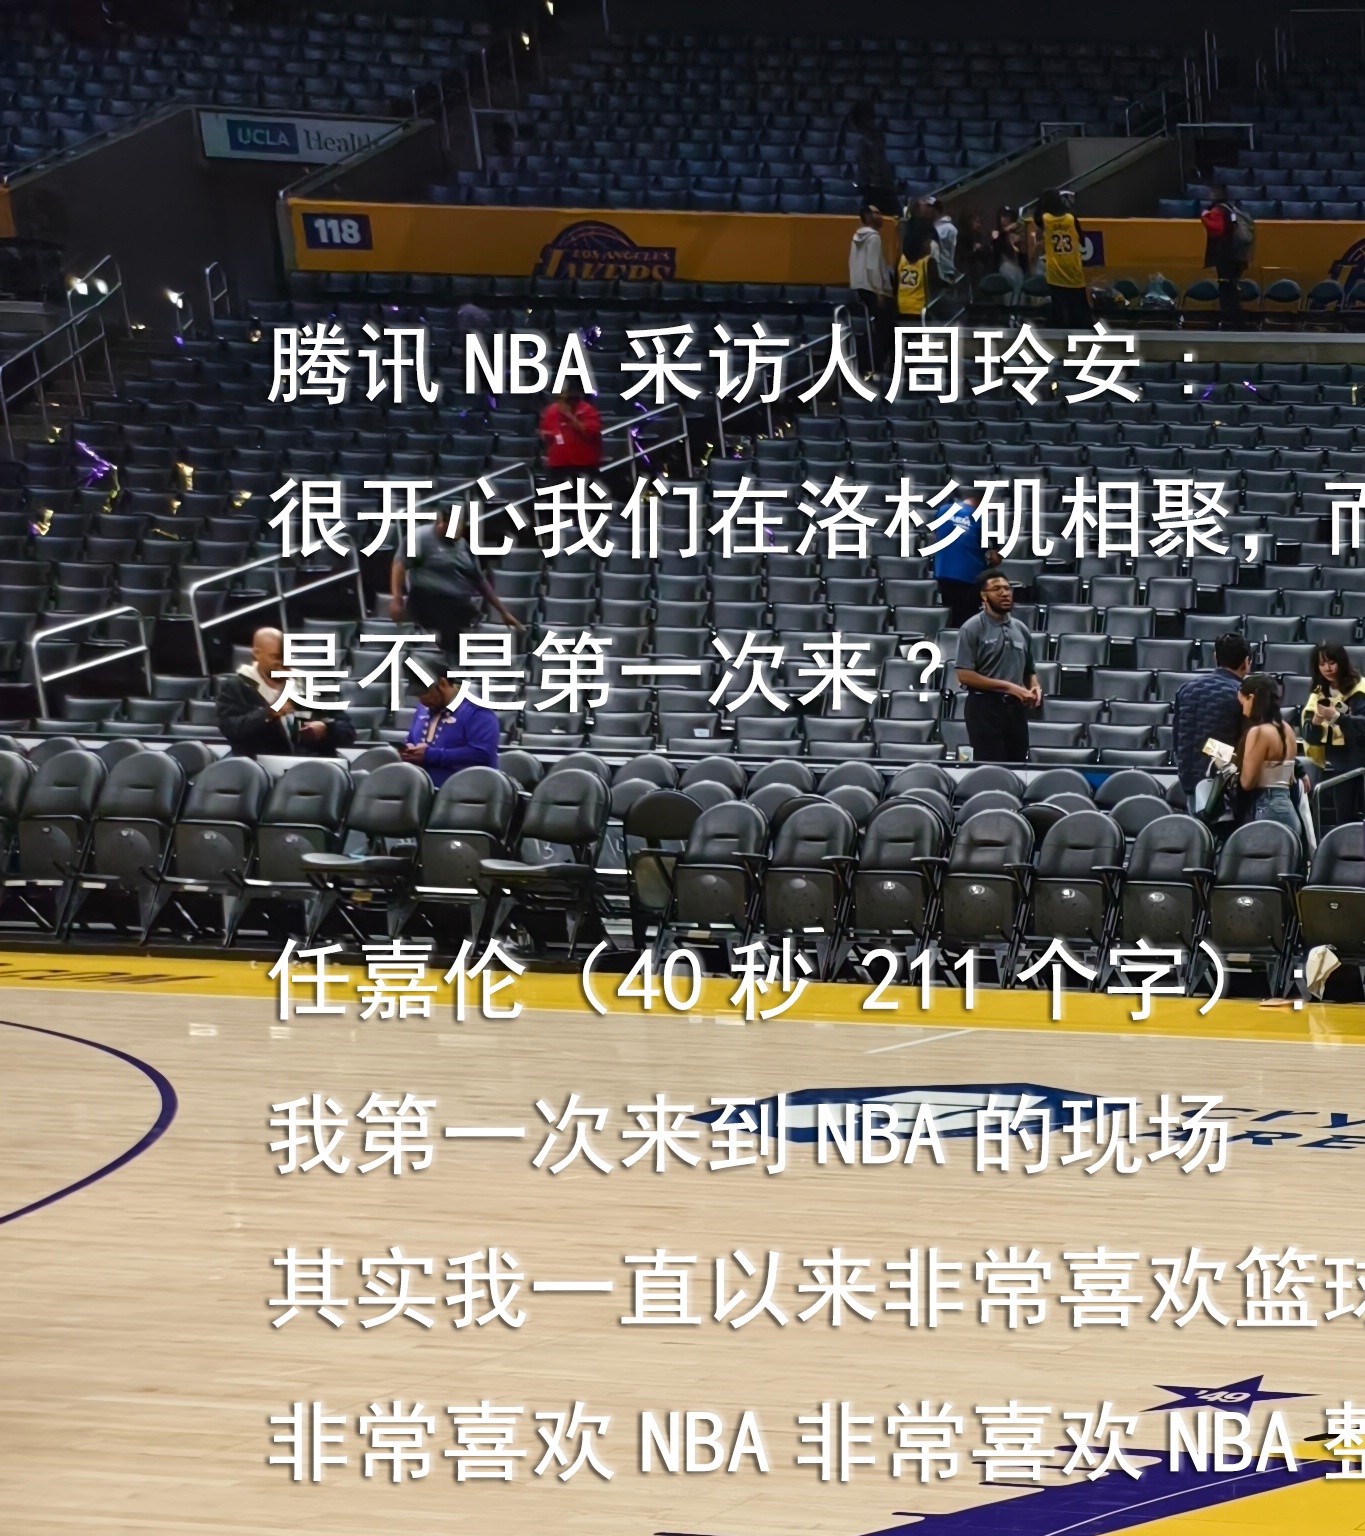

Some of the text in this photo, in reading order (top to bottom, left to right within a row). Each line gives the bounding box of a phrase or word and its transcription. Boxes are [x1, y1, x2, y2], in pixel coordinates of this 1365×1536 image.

[237, 127, 291, 147] UCLA
[313, 218, 361, 244] 118
[1194, 1388, 1252, 1404] '49
